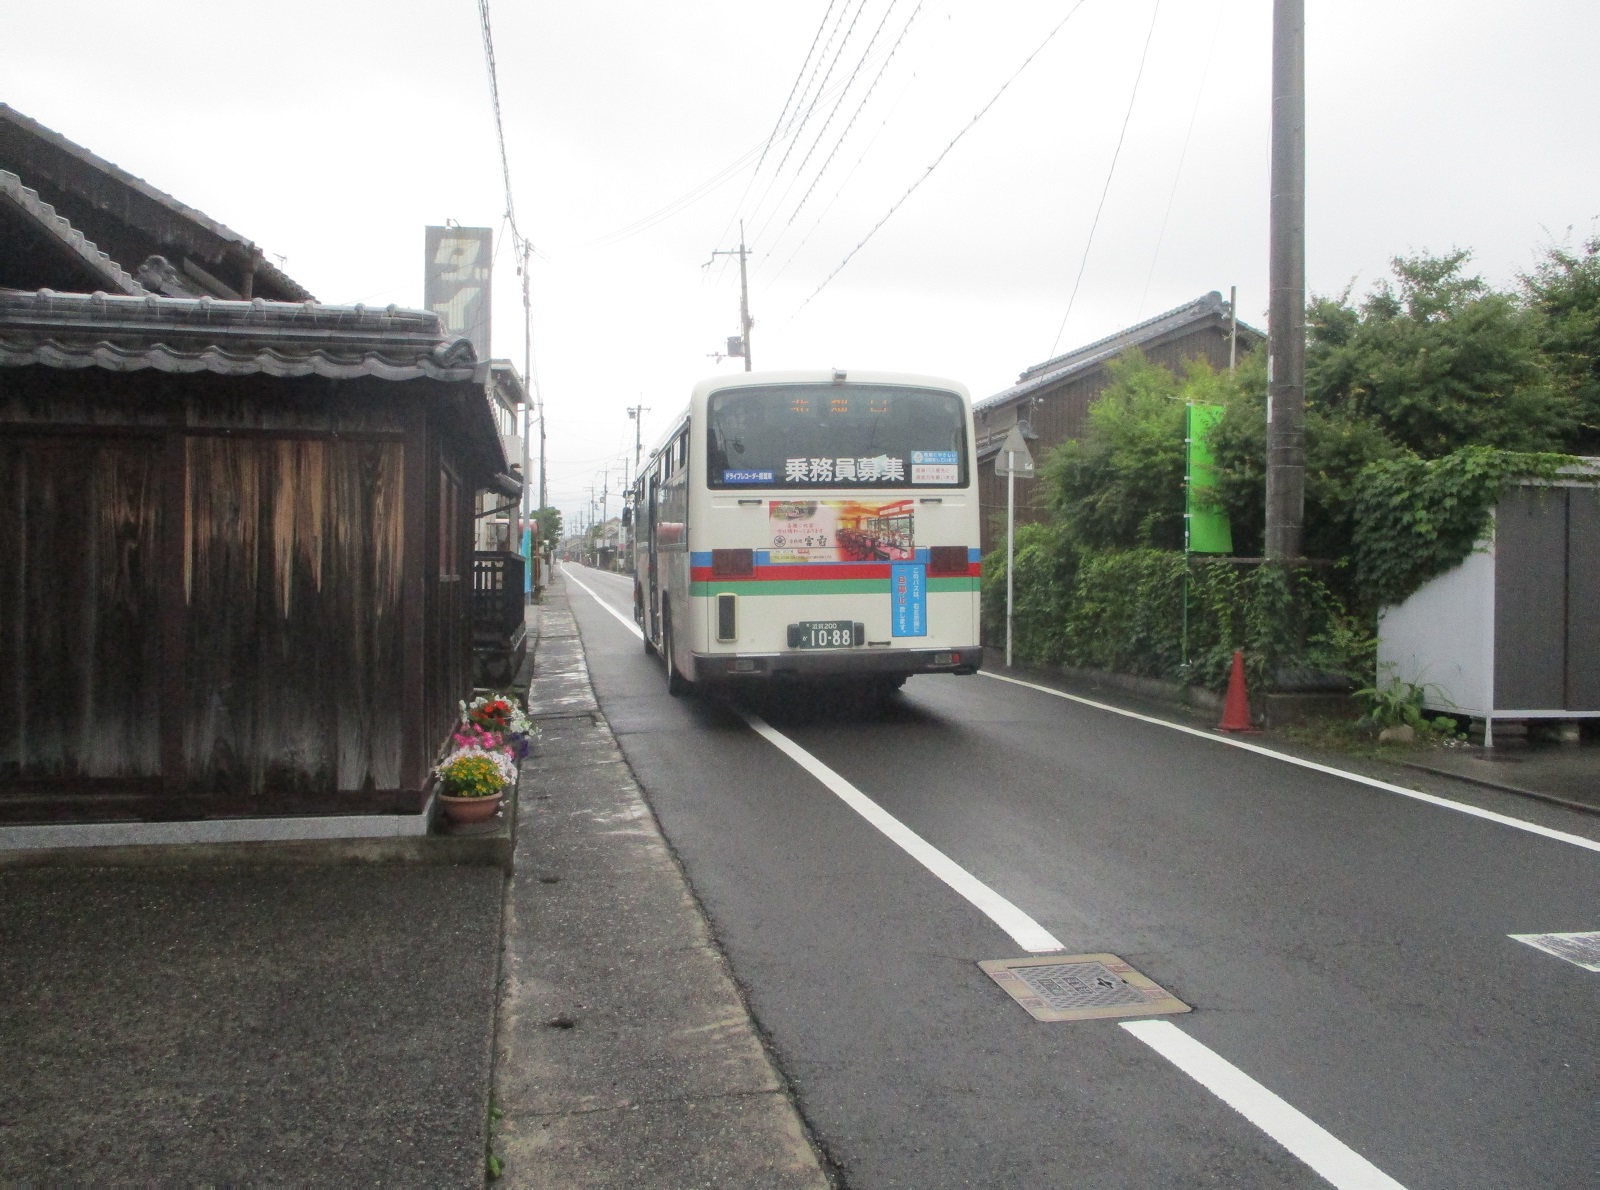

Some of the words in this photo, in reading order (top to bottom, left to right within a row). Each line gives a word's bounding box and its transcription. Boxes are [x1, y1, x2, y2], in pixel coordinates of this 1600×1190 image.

[785, 457, 905, 482] 乗務員募集
[811, 629, 851, 647] 10-88
